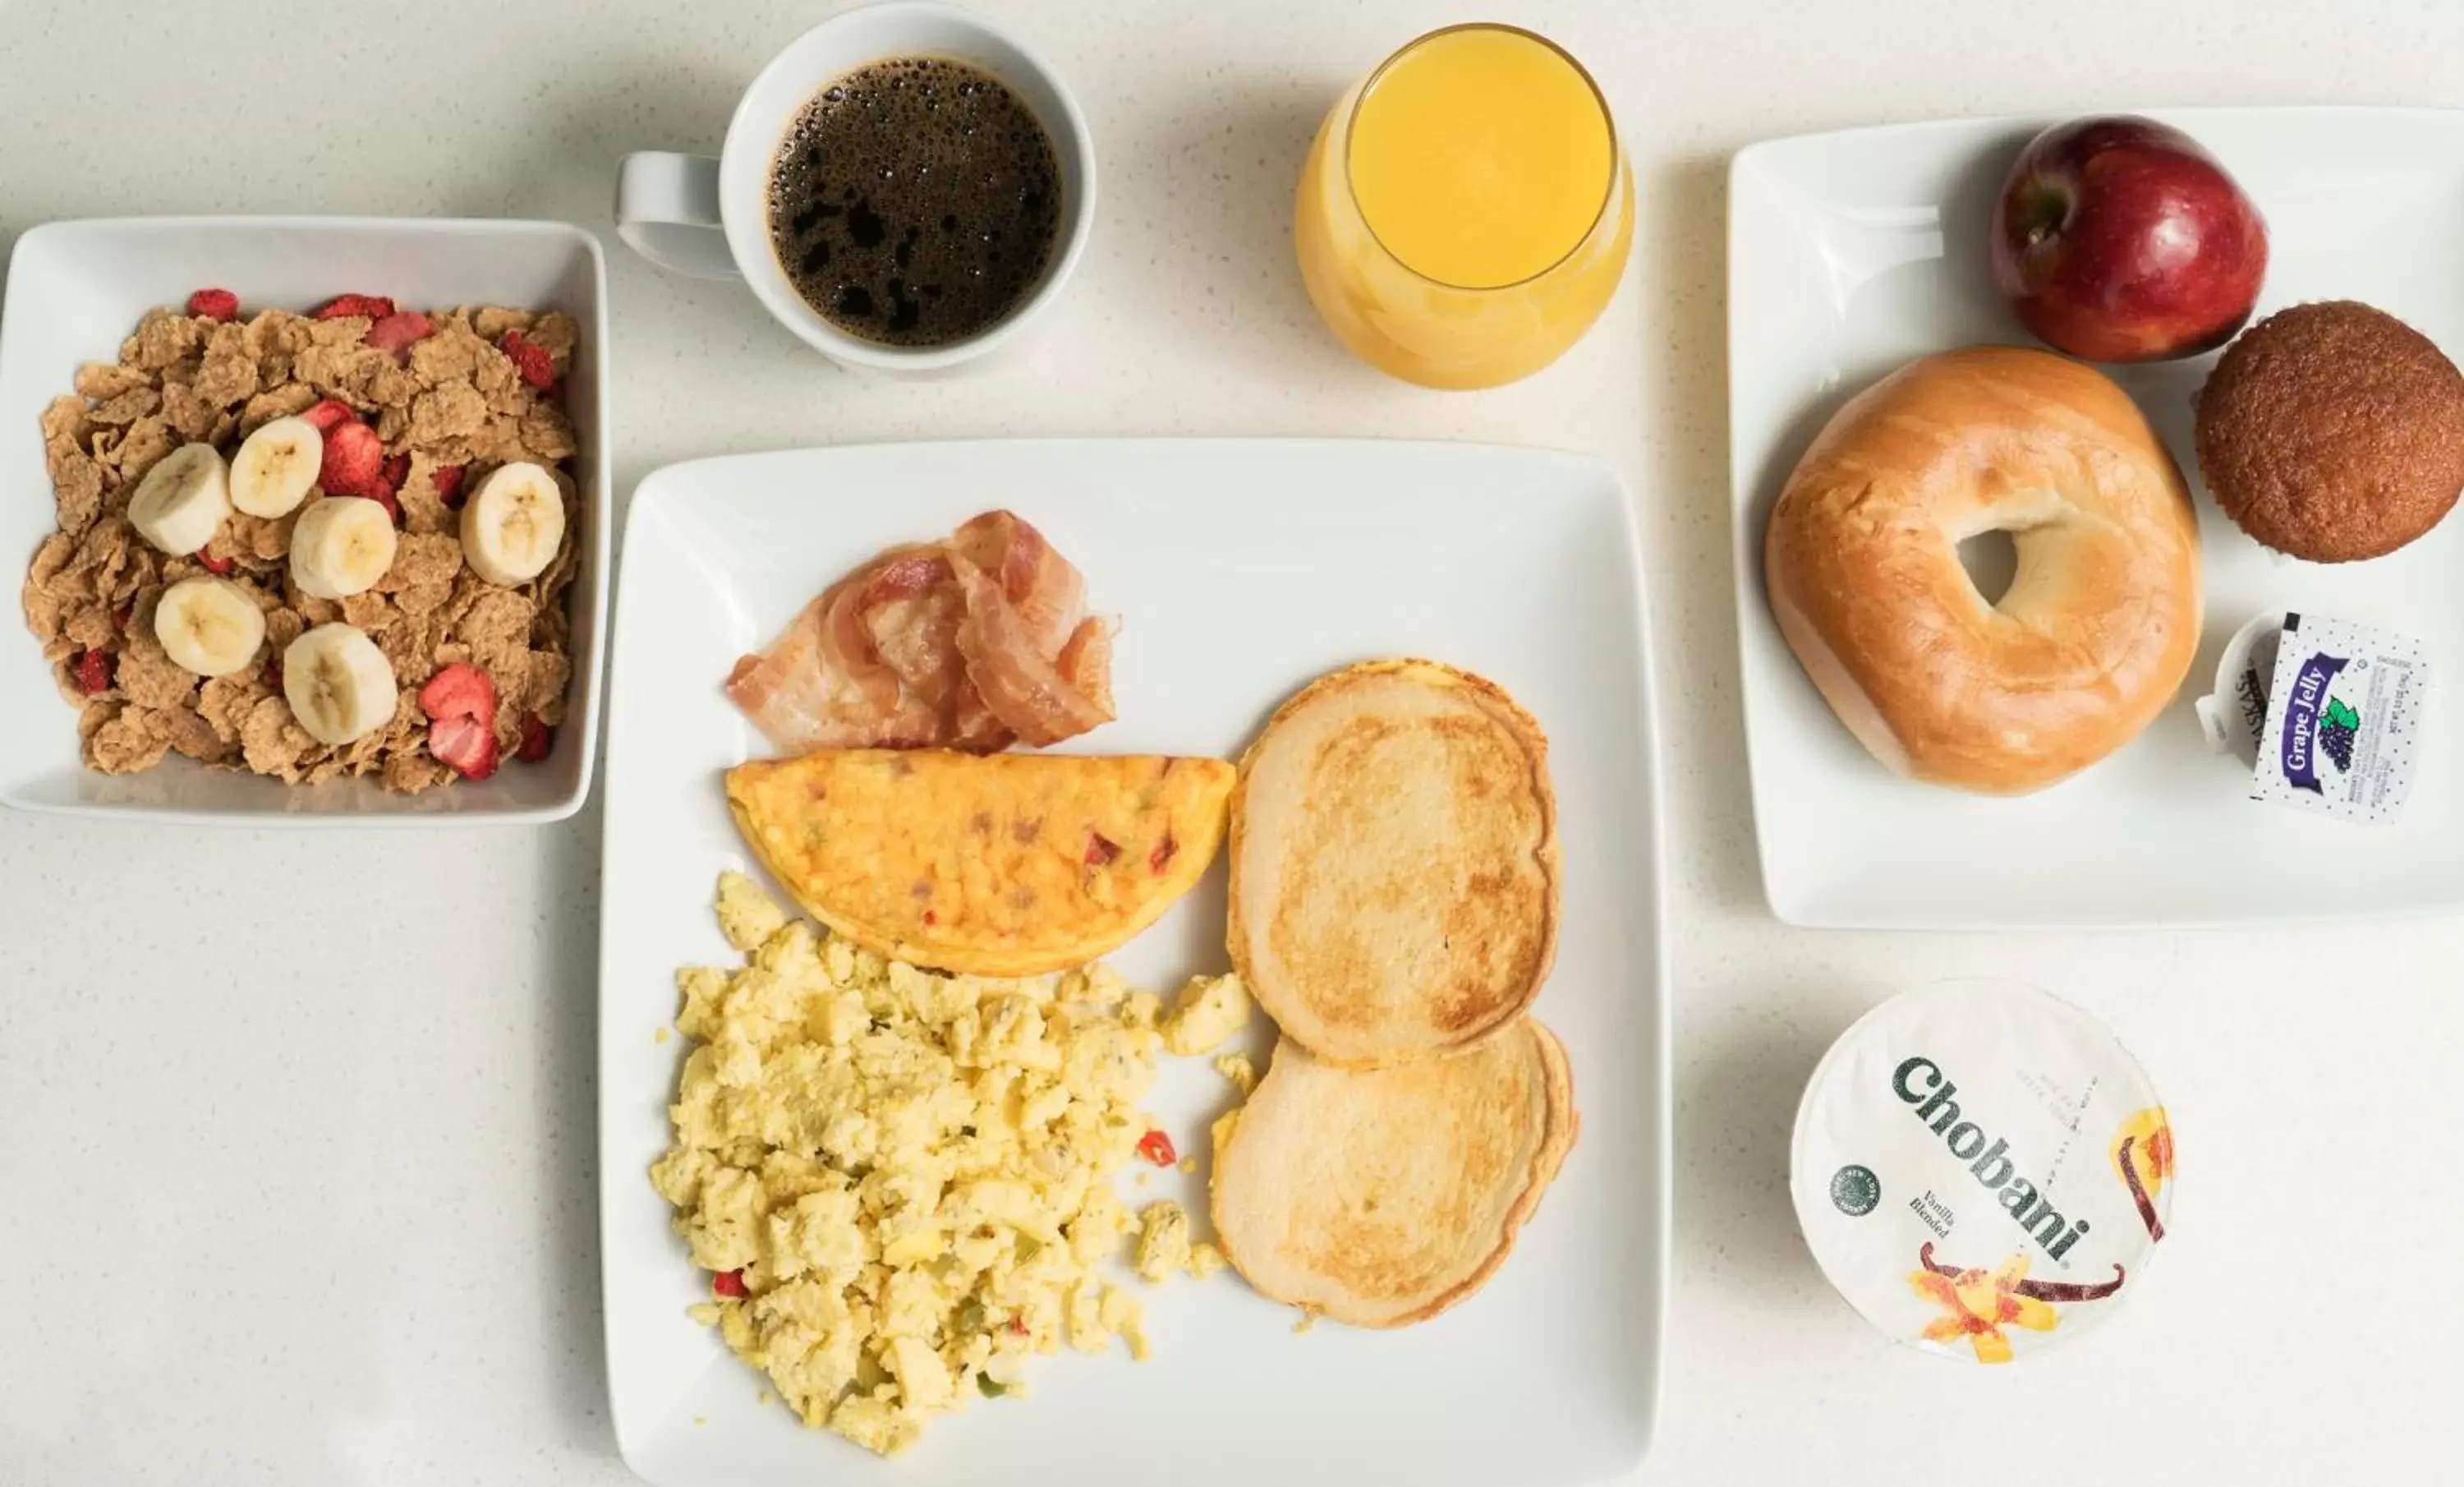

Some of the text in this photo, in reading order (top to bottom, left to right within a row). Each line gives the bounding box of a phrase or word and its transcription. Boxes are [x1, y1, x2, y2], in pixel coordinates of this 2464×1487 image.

[2287, 667, 2328, 771] Grape Jelly
[1892, 1056, 2090, 1261] Chobani
[1909, 1198, 1949, 1239] Blended
[1924, 1190, 1956, 1227] Vanilla
